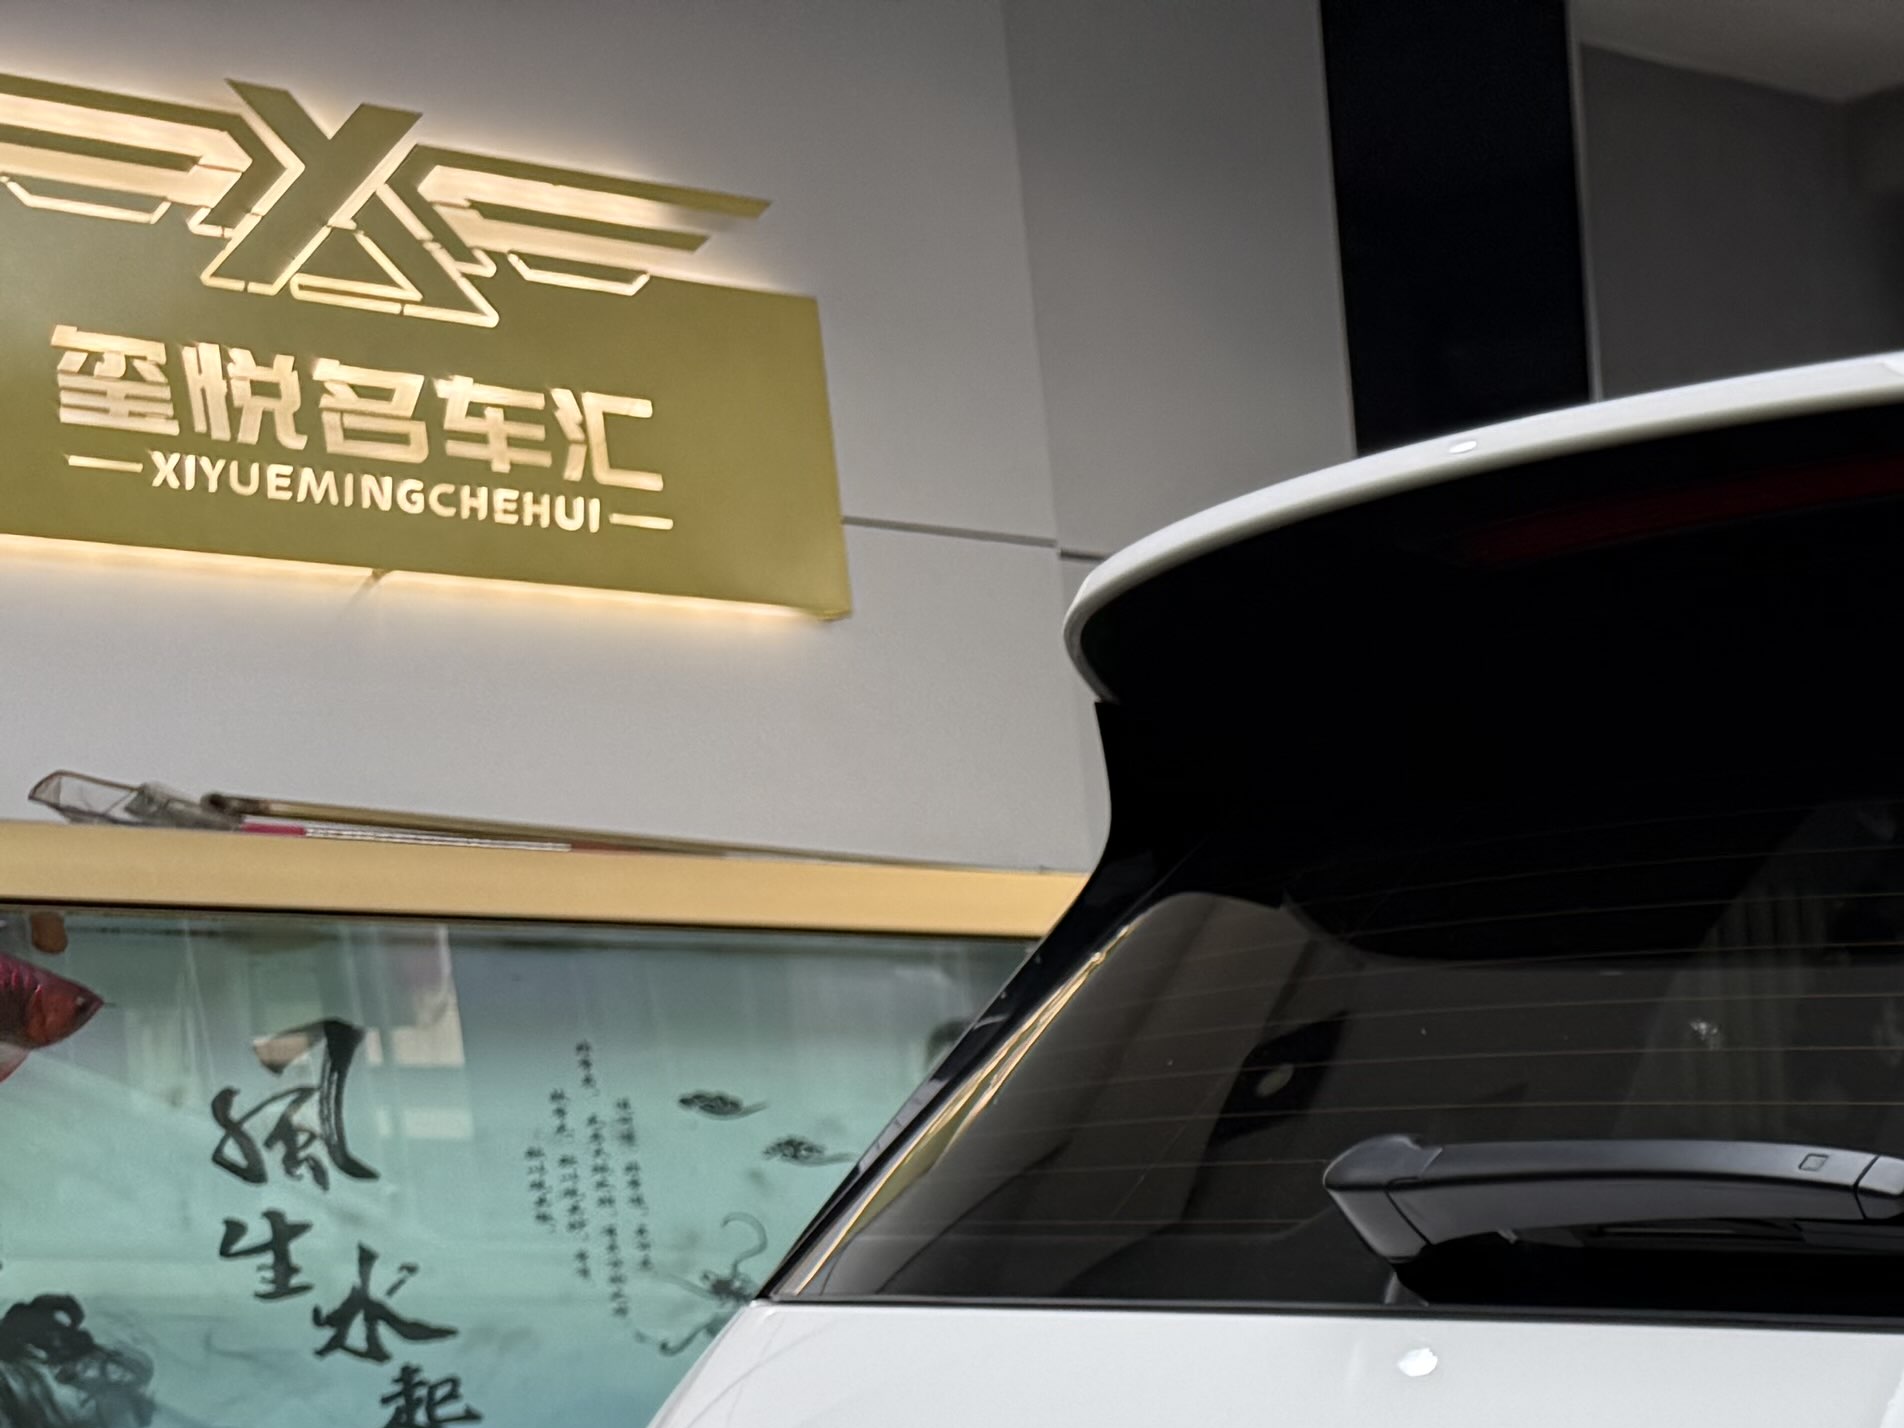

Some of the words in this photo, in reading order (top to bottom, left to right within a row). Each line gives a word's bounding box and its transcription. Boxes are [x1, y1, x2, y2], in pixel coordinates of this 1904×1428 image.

[51, 325, 665, 491] 玺悦名车汇
[152, 450, 601, 534] XIYUEMINGCHEHUI
